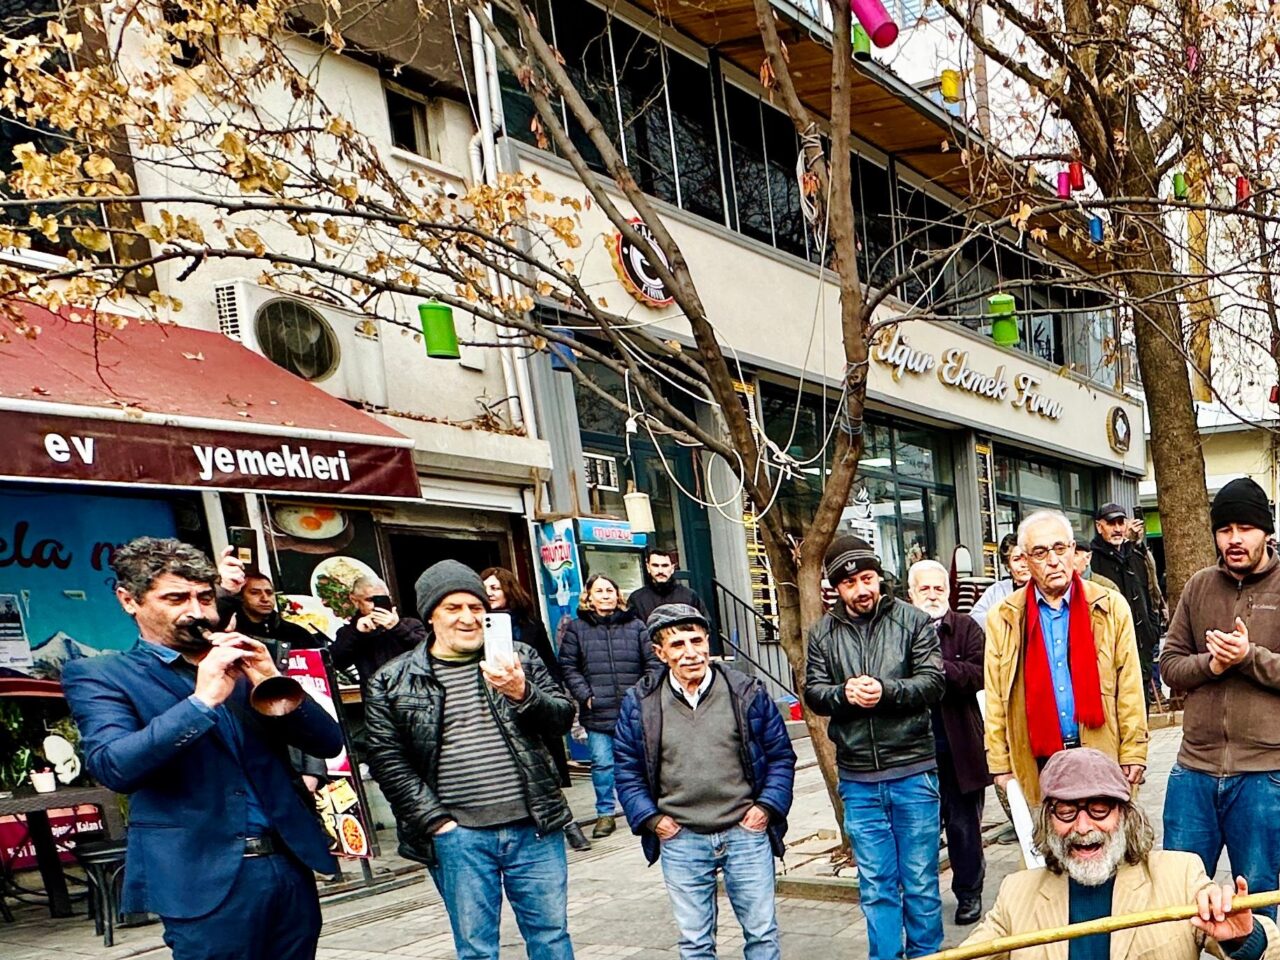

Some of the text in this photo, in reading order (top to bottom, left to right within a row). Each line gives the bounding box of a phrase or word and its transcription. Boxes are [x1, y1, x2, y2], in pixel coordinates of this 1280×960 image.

[942, 347, 1008, 400] Ekmek
[44, 432, 351, 482] ev yemekleri
[593, 527, 632, 540] munzu
